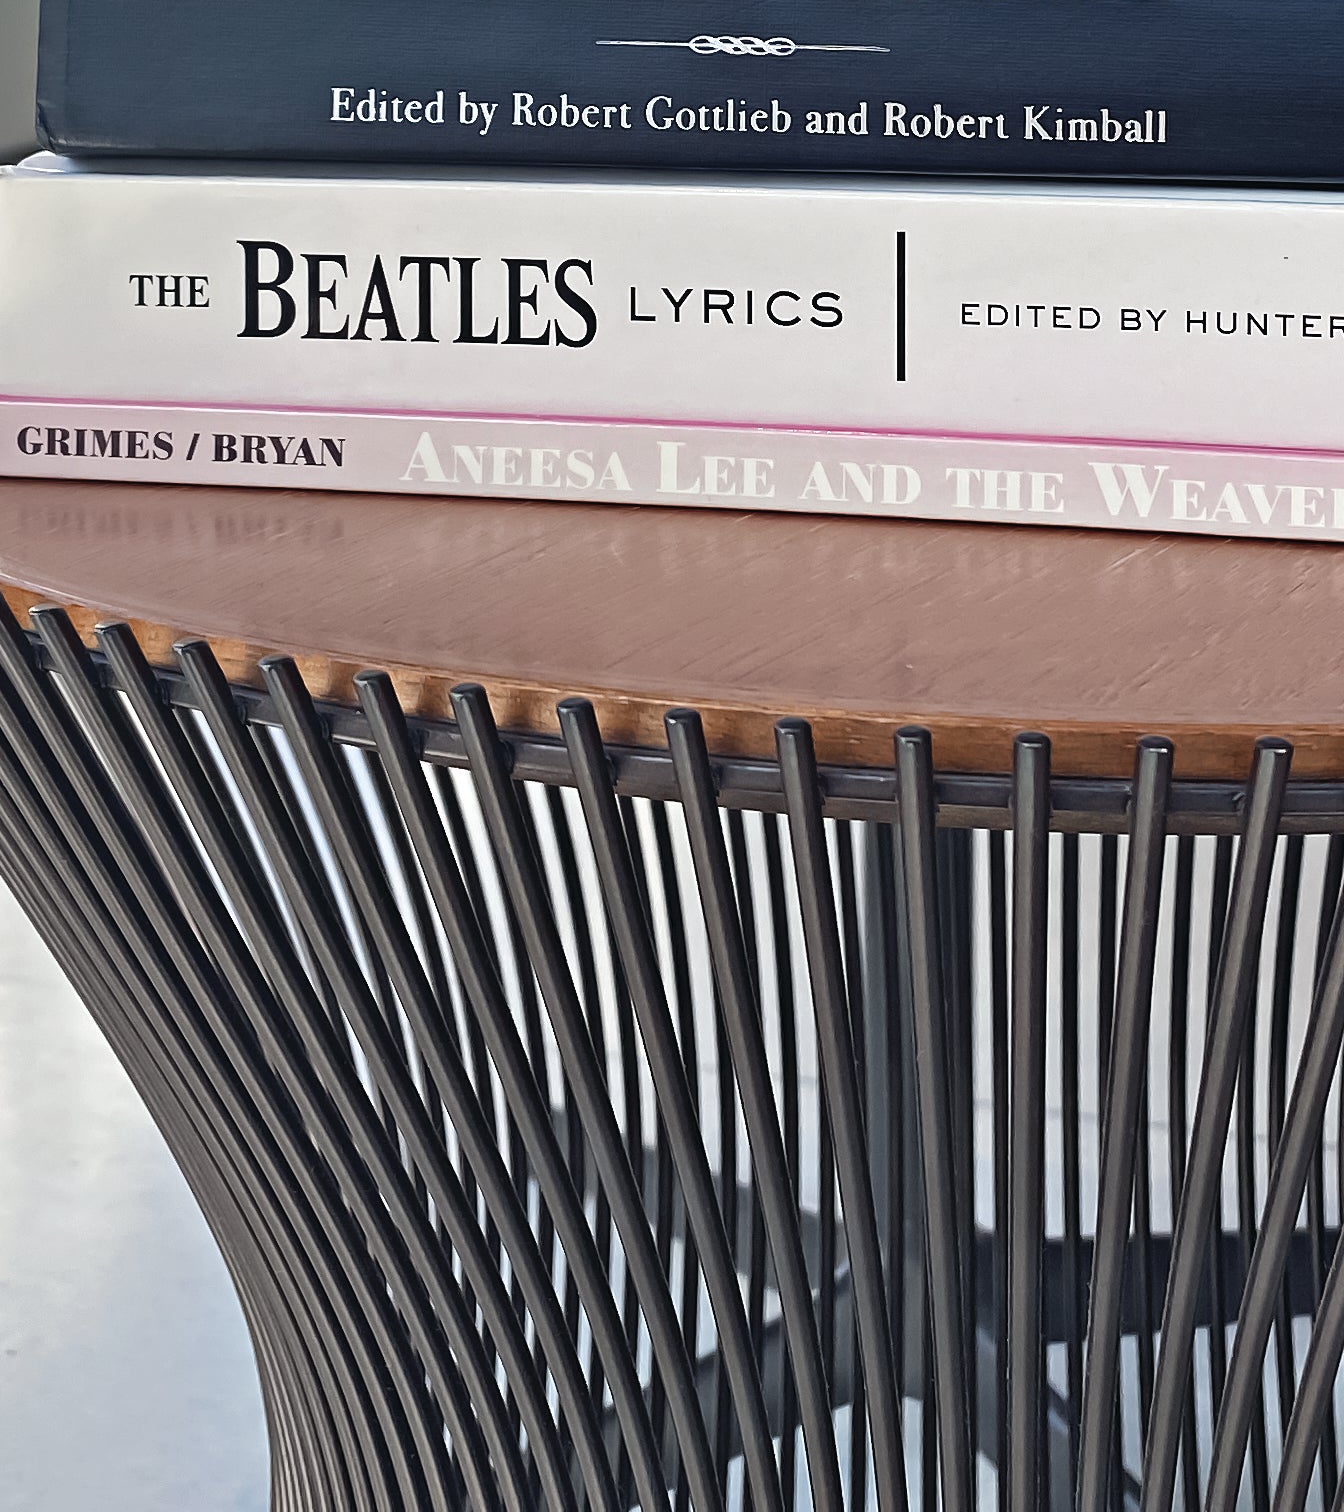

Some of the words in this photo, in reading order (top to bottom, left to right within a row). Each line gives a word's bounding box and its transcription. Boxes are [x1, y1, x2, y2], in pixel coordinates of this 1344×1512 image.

[330, 87, 445, 124] Edited
[458, 91, 499, 136] by
[511, 92, 632, 129] Robert
[645, 95, 792, 133] Gottlieb
[805, 101, 869, 136] and
[883, 102, 1010, 139] Robert
[1023, 105, 1166, 143] Kimball
[128, 274, 210, 308] THE
[235, 239, 597, 349] BEATLES
[630, 286, 843, 328] LYRICS
[961, 303, 1101, 330] EDITED
[1120, 308, 1167, 332] BY
[16, 426, 174, 461] GRIMES
[185, 432, 201, 461] /
[211, 433, 346, 467] BRYAN
[398, 430, 634, 493] ANEESA
[655, 441, 777, 500] LEE
[798, 461, 923, 507] AND
[945, 467, 1066, 516] THE
